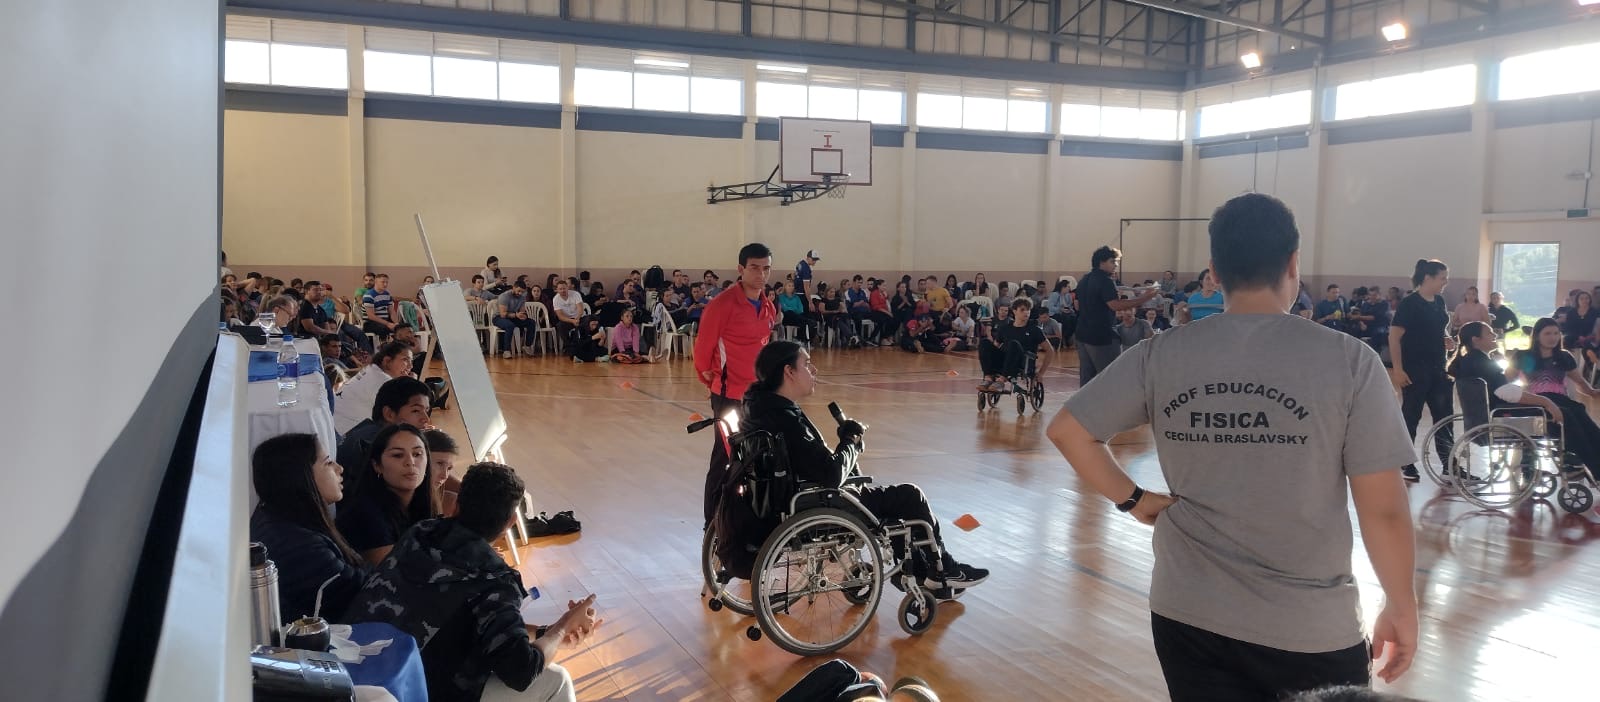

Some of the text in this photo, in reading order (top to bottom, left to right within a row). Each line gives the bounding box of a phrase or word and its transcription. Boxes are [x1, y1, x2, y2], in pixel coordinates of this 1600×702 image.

[1163, 382, 1310, 421] PROF EDUCACION
[1190, 411, 1270, 429] FISICA
[1164, 431, 1308, 445] CECILIA BRASLAVSKY
